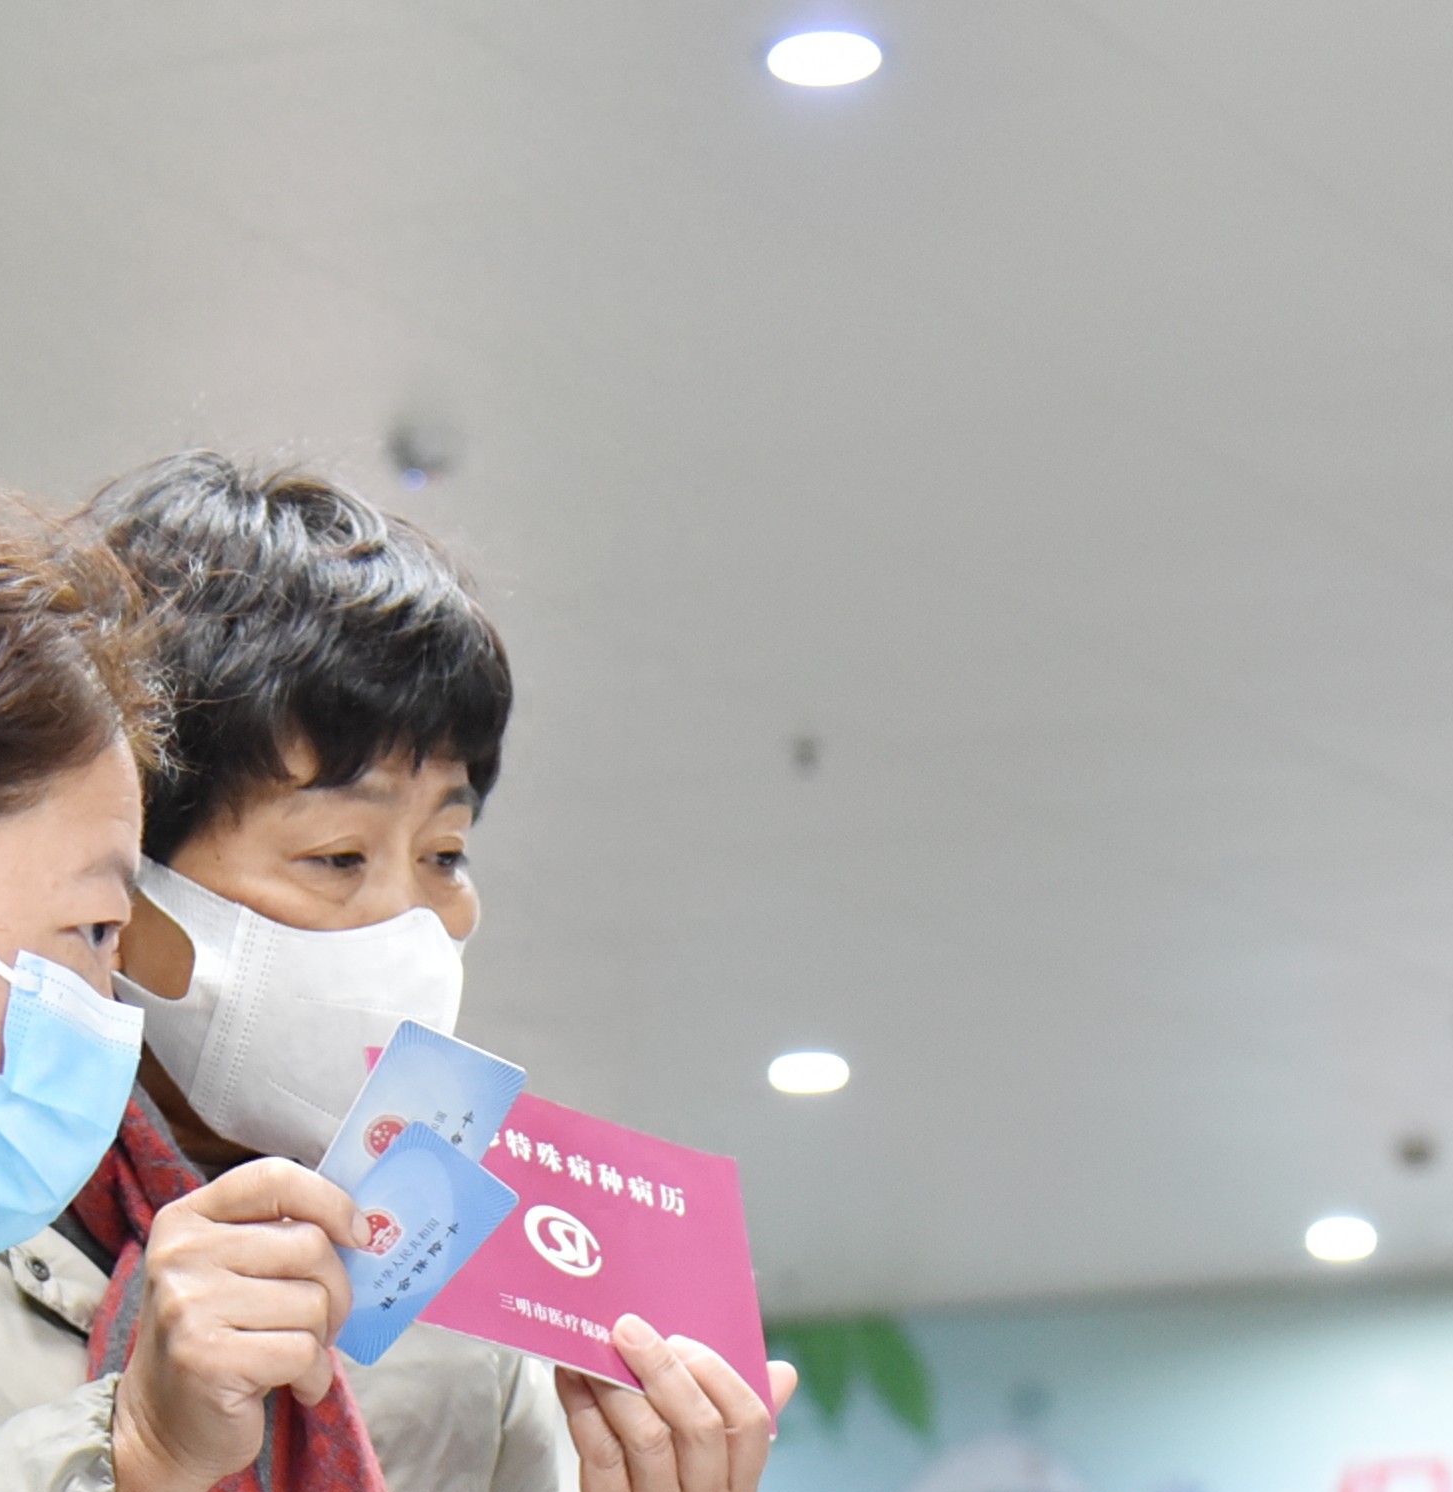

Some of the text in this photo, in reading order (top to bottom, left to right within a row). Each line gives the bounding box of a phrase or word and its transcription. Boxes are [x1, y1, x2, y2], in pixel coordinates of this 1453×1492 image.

[489, 1128, 686, 1217] 特殊病种病历
[372, 1217, 440, 1291] 中华人民共和国
[498, 1292, 613, 1344] 三明市医疗保障
